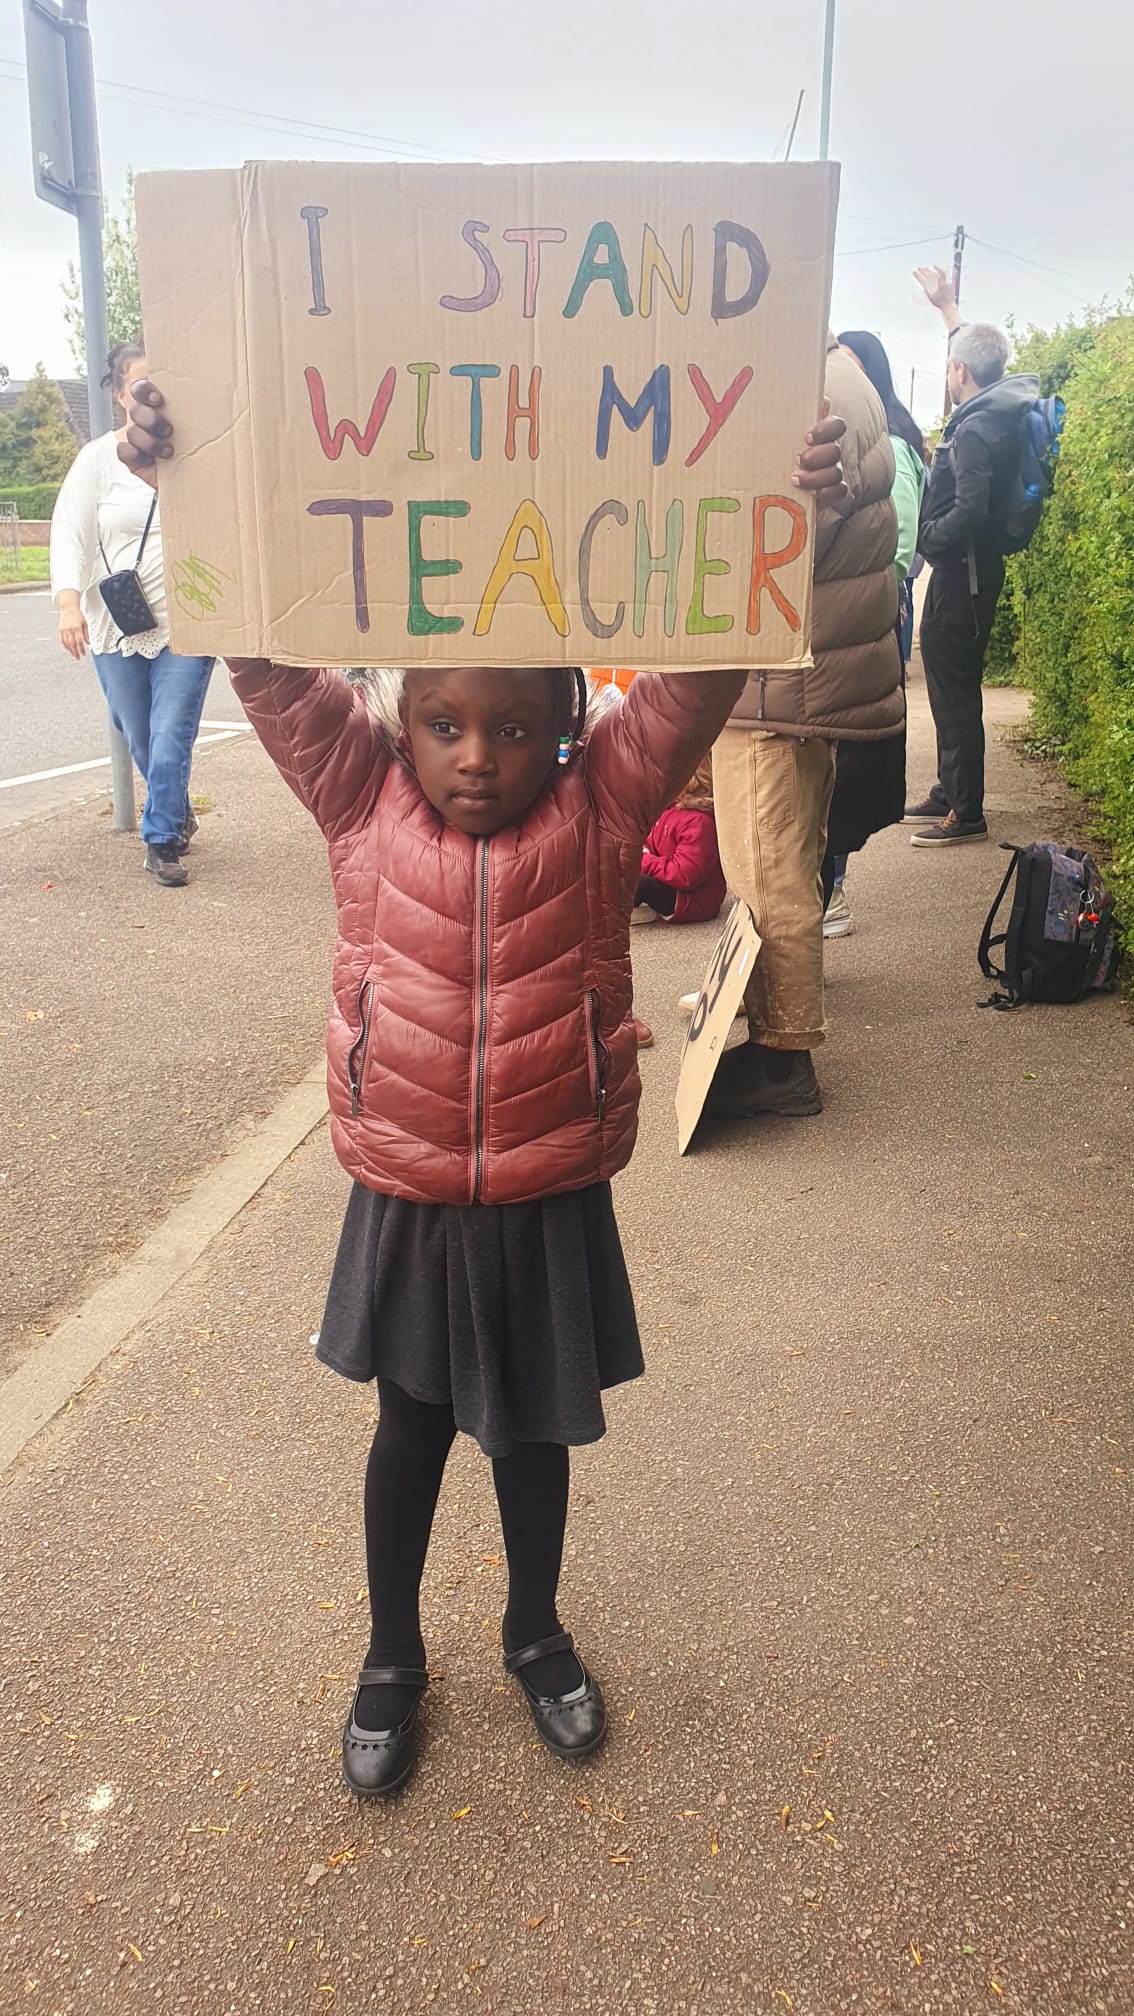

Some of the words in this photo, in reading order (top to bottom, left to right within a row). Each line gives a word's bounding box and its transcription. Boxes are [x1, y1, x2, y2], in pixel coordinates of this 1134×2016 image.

[301, 206, 331, 315] I
[439, 220, 771, 325] STAND
[304, 363, 542, 461] WITH
[596, 364, 754, 467] MY
[308, 496, 808, 638] TEACHER
